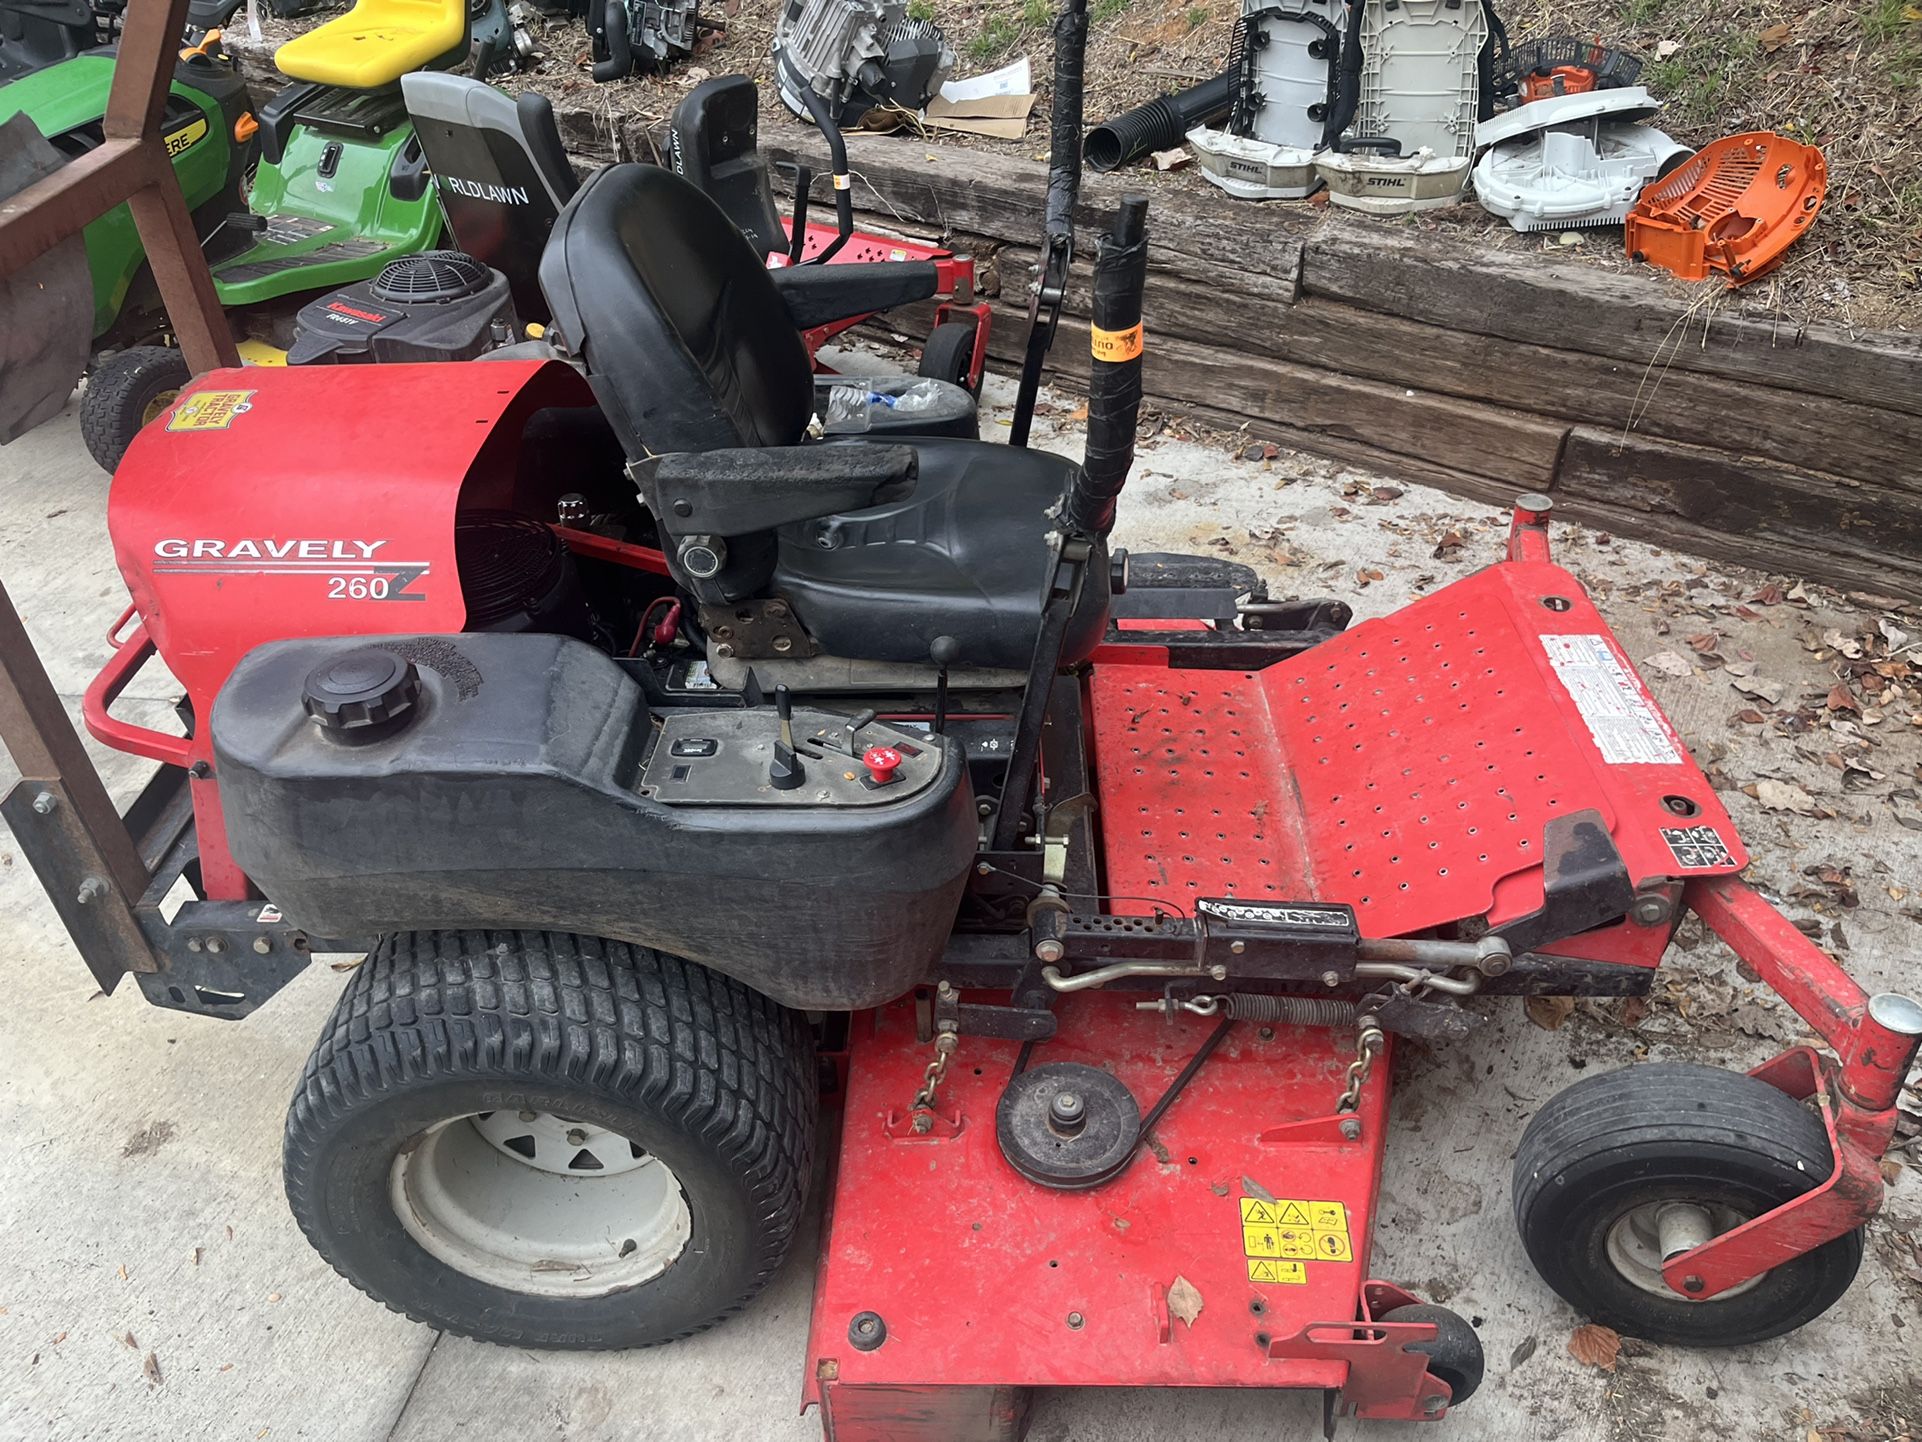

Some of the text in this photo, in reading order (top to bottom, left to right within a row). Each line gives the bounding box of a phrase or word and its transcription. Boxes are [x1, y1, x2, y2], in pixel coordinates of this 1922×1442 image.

[671, 129, 684, 175] DLAWN
[1230, 161, 1262, 174] STIHL
[434, 174, 530, 205] RLDLAWN
[1367, 177, 1405, 187] STIHL
[326, 301, 387, 323] Kawasaki
[153, 539, 390, 559] GRAVELY
